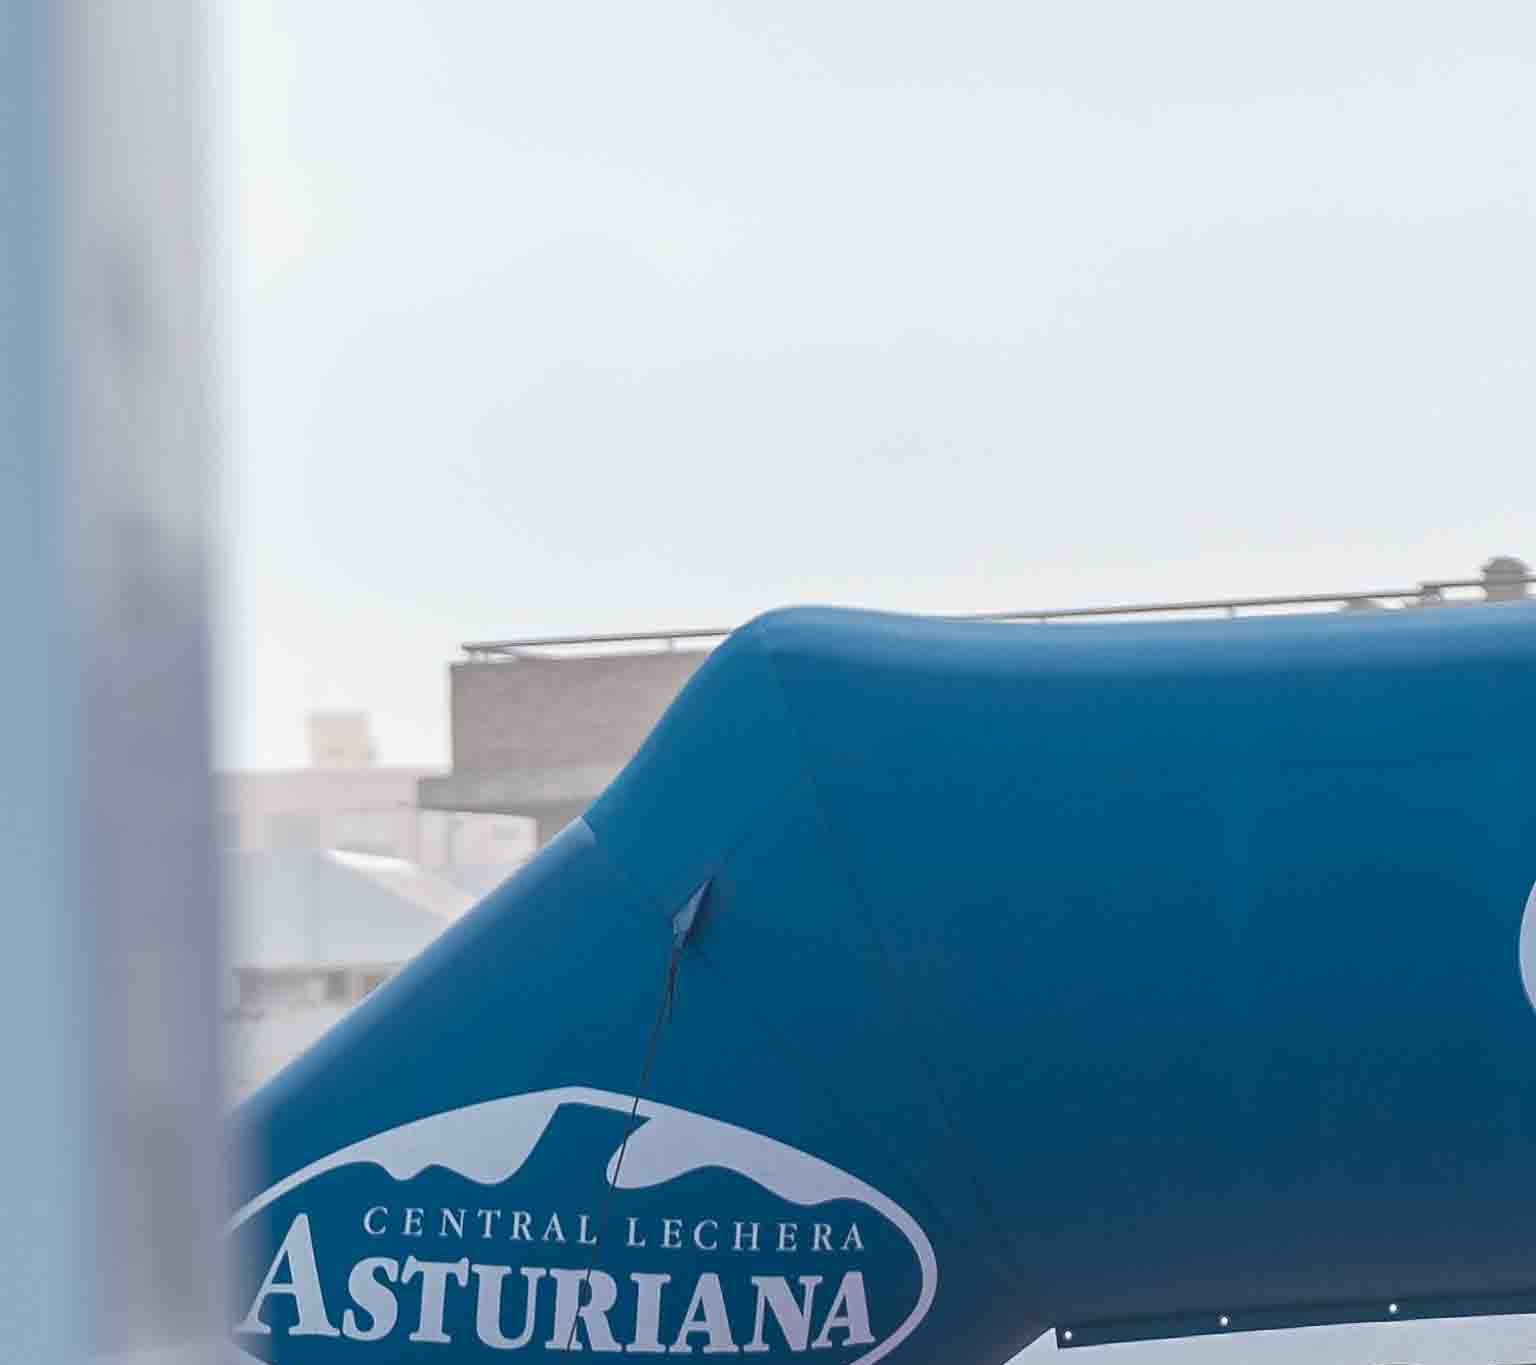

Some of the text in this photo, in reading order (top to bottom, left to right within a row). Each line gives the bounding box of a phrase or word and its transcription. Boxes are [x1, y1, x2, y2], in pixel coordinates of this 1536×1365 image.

[364, 1205, 867, 1252] CENTRAL LECHERA
[236, 1212, 877, 1354] ASTURIANA
